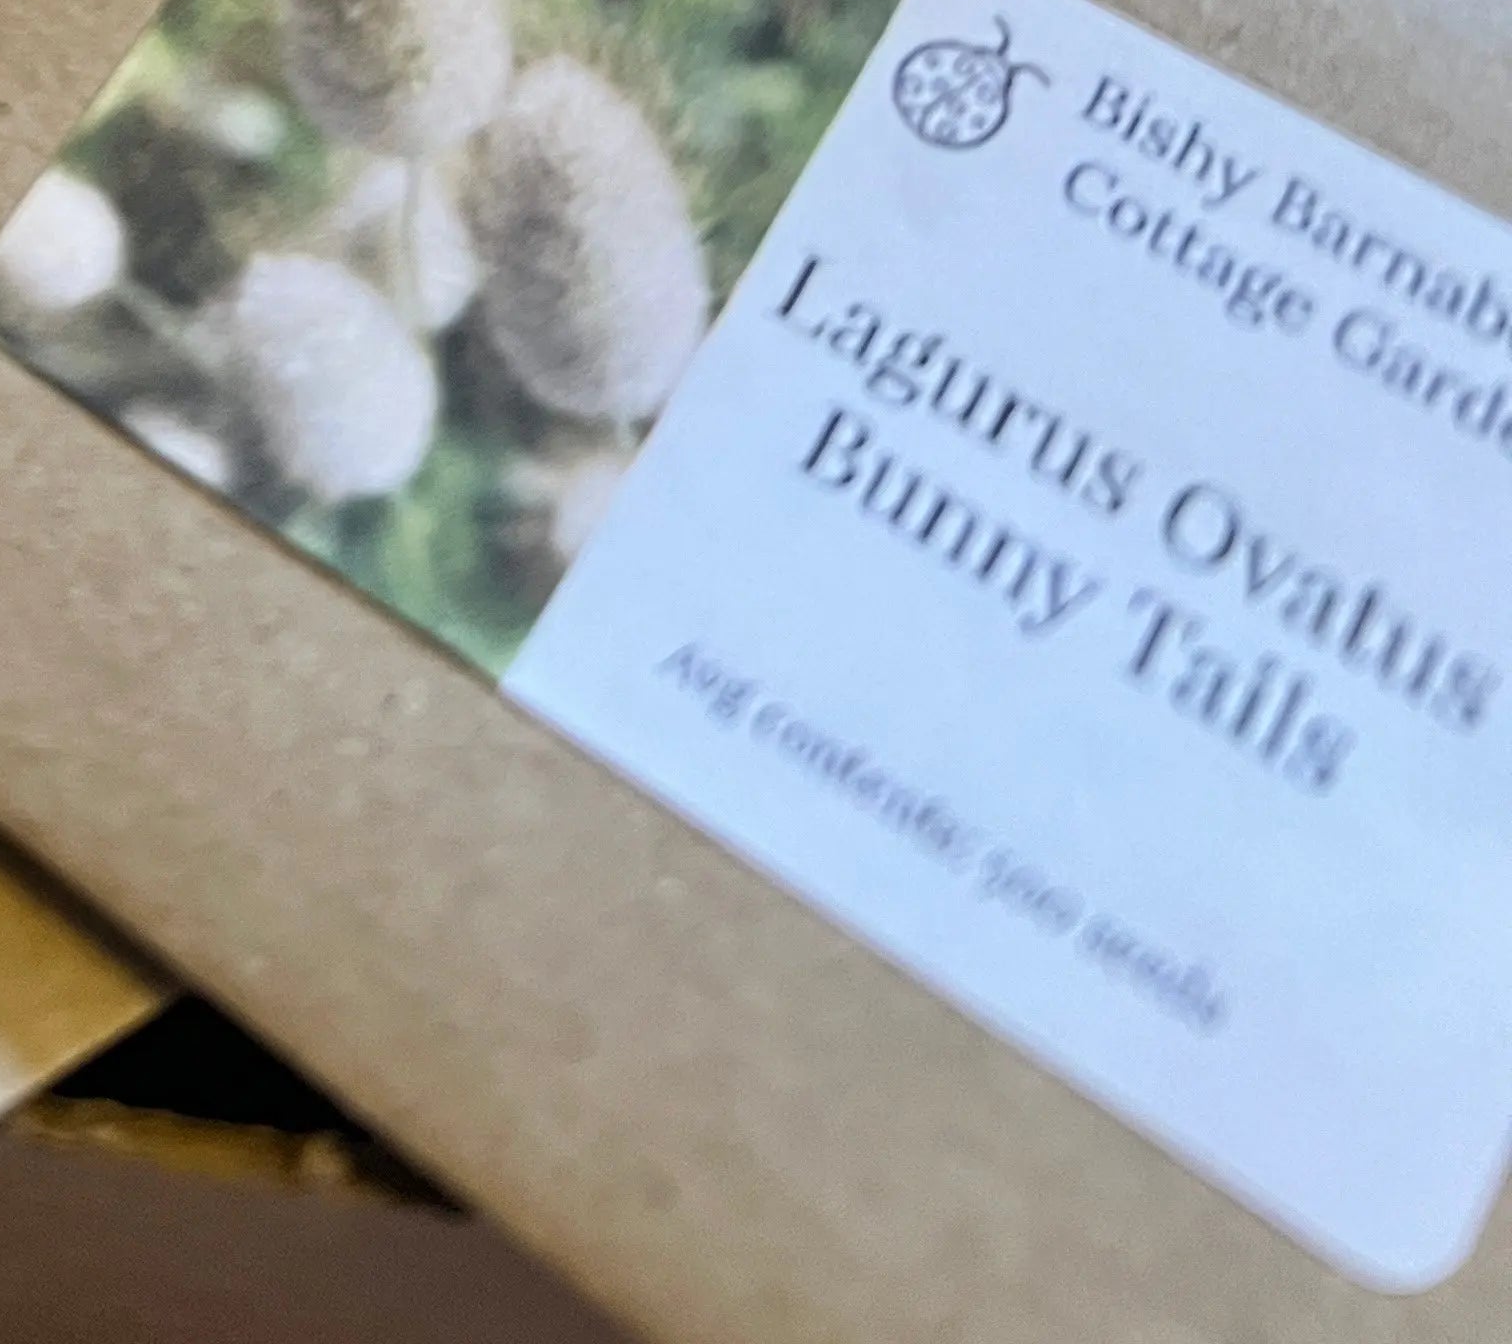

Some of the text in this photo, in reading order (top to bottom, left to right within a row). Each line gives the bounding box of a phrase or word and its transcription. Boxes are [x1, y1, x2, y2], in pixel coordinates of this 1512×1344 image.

[1064, 161, 1315, 334] Cottage
[1082, 74, 1512, 358] Bishy Barnab
[774, 253, 1501, 730] Lagurus Ovatus
[799, 405, 1357, 796] Bunny Tails
